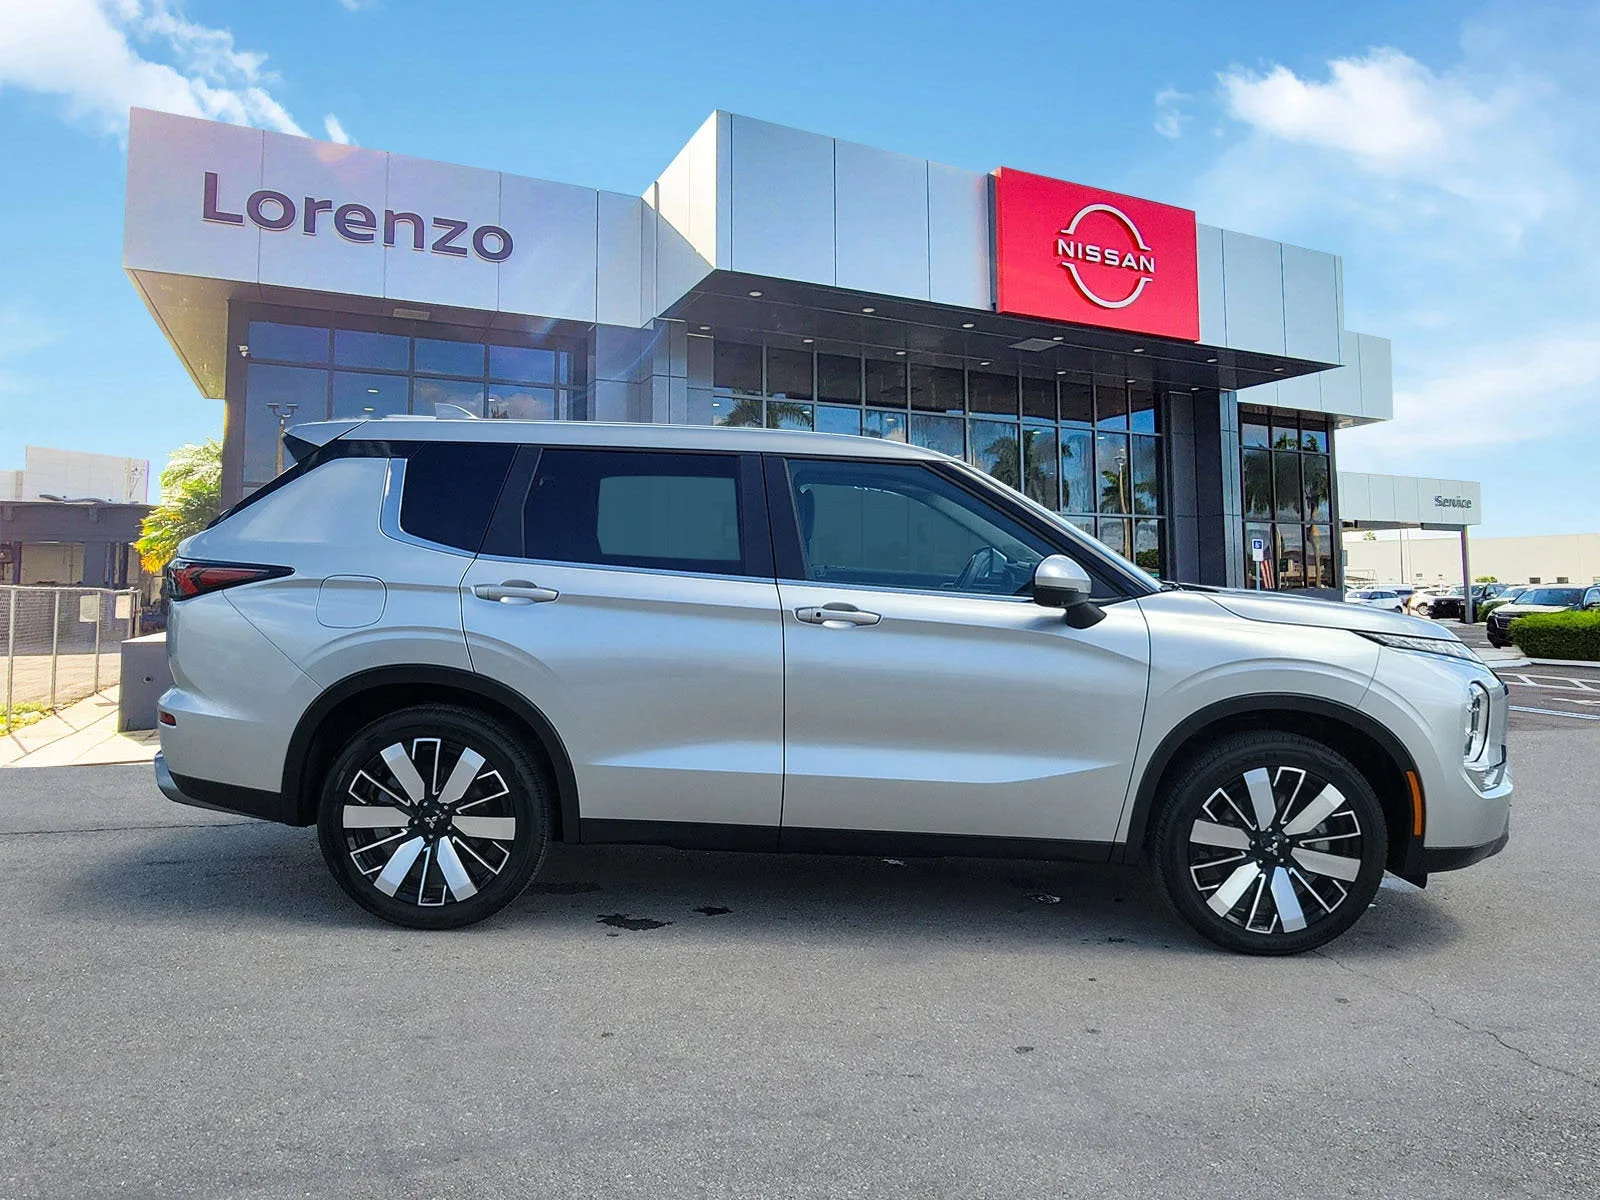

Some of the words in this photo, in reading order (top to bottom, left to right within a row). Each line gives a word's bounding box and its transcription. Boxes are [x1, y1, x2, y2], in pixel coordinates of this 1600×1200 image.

[202, 171, 514, 263] Lorenzo
[1057, 239, 1155, 273] NISSAN
[1435, 495, 1472, 509] Service
